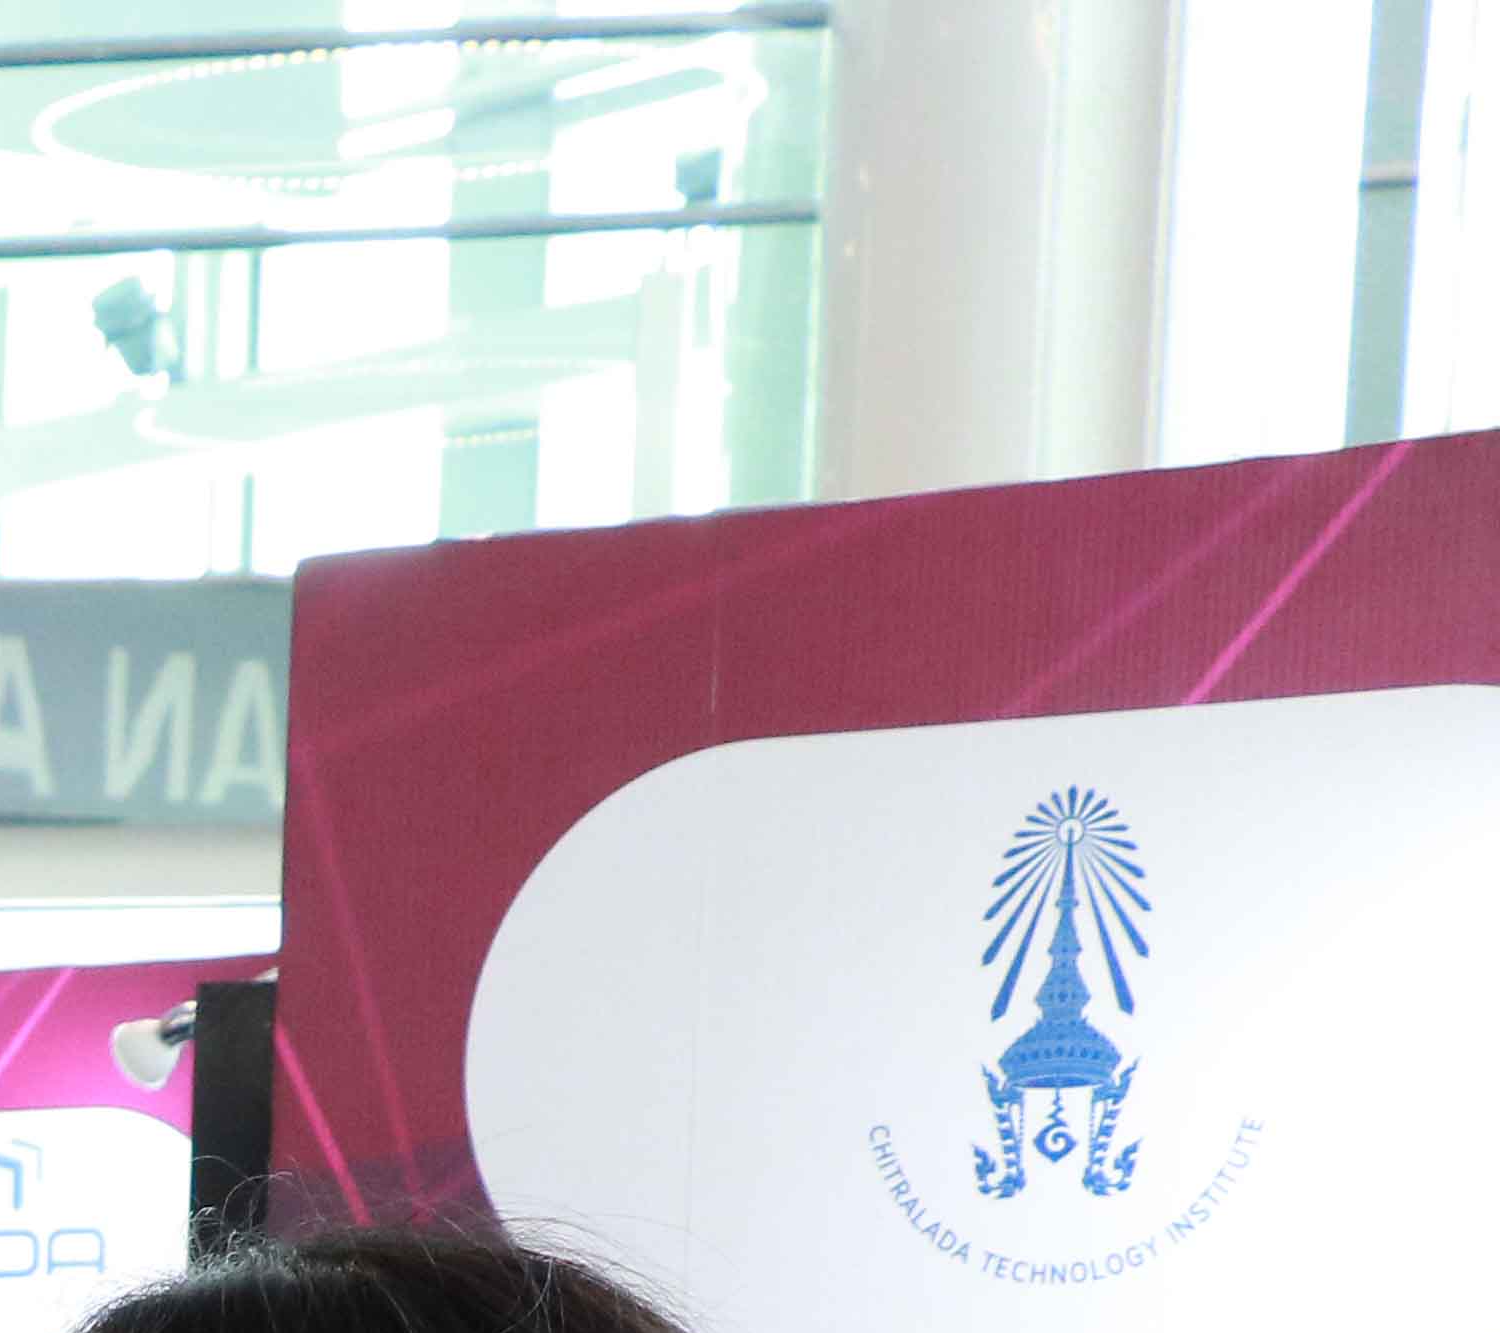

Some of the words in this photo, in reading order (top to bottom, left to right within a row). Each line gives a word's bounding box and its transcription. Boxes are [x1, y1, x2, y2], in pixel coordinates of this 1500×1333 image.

[867, 1123, 972, 1265] CHITRALADA
[980, 1235, 1159, 1286] TECHNOLOGY
[1165, 1114, 1266, 1245] INSTITUTE
